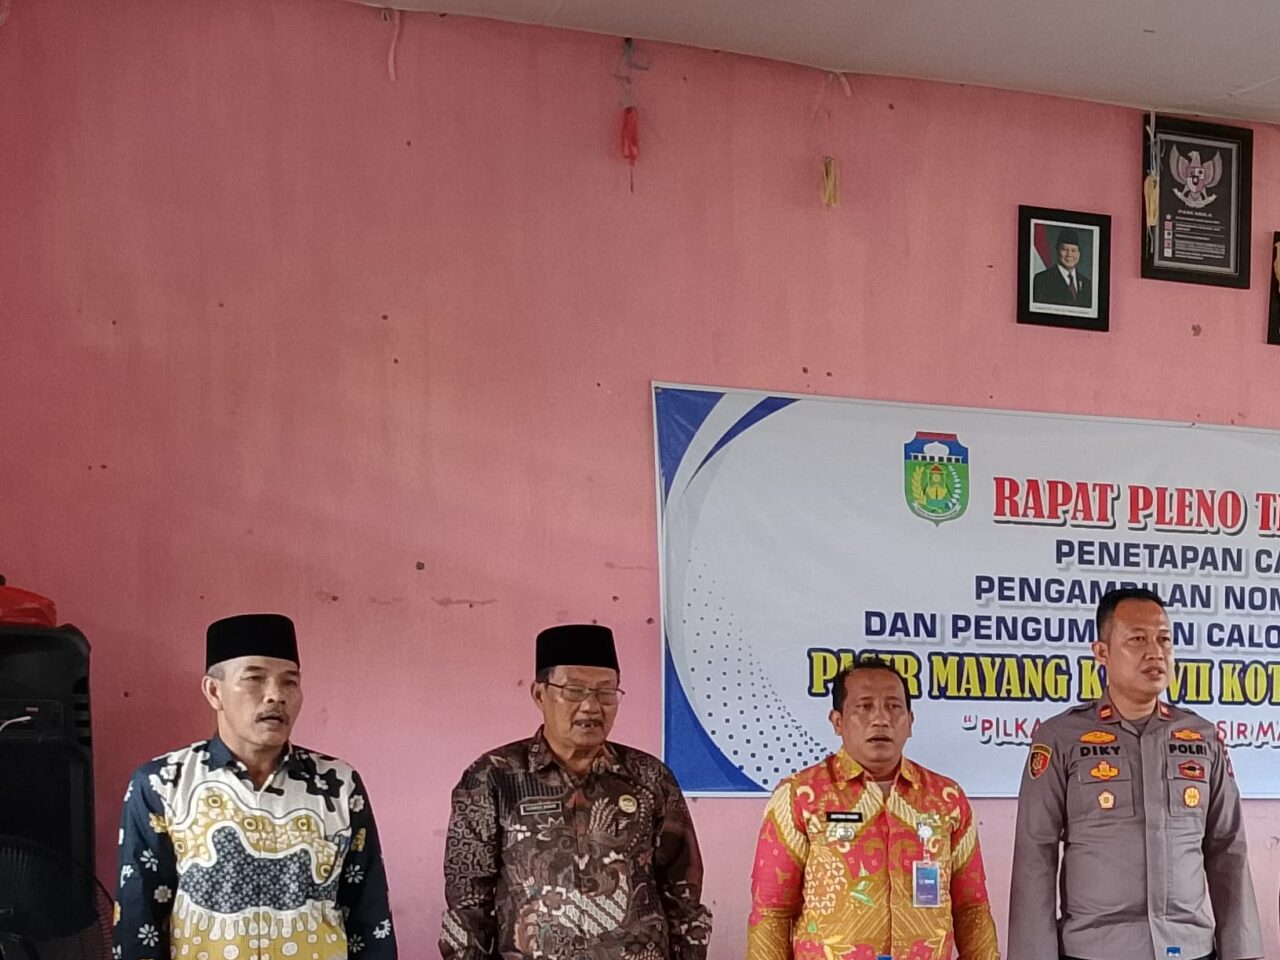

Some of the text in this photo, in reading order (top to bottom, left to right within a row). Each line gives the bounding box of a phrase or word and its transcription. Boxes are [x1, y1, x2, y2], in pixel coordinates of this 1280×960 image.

[993, 476, 1116, 525] RAPAT
[1128, 484, 1243, 529] PLENO
[1055, 539, 1242, 573] PENETAPAN
[865, 611, 937, 638] DAN
[951, 614, 1194, 646] PENGUMN
[929, 652, 1071, 701] MAYANG
[1216, 720, 1248, 740] SIR
[1080, 746, 1120, 757] DIKY
[1169, 743, 1207, 757] POLRI
